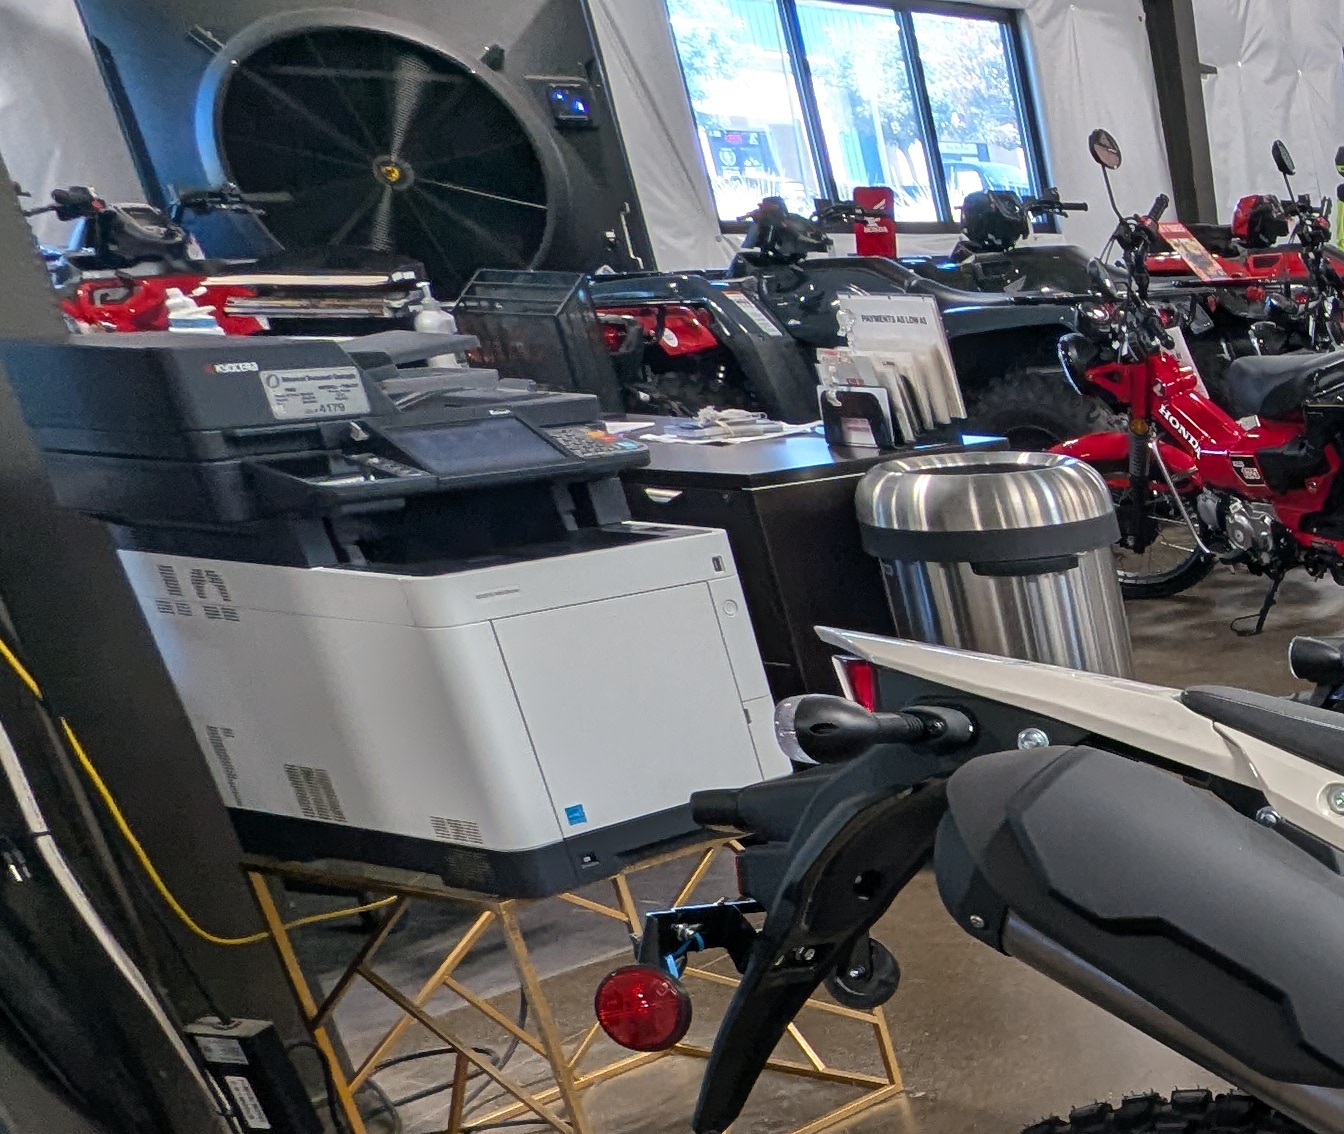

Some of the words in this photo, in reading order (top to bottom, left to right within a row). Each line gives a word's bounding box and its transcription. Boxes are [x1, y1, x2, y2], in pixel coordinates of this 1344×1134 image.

[861, 314, 896, 323] PAYMENTS
[897, 316, 906, 324] AS
[906, 316, 918, 324] LOW
[919, 317, 927, 325] AS
